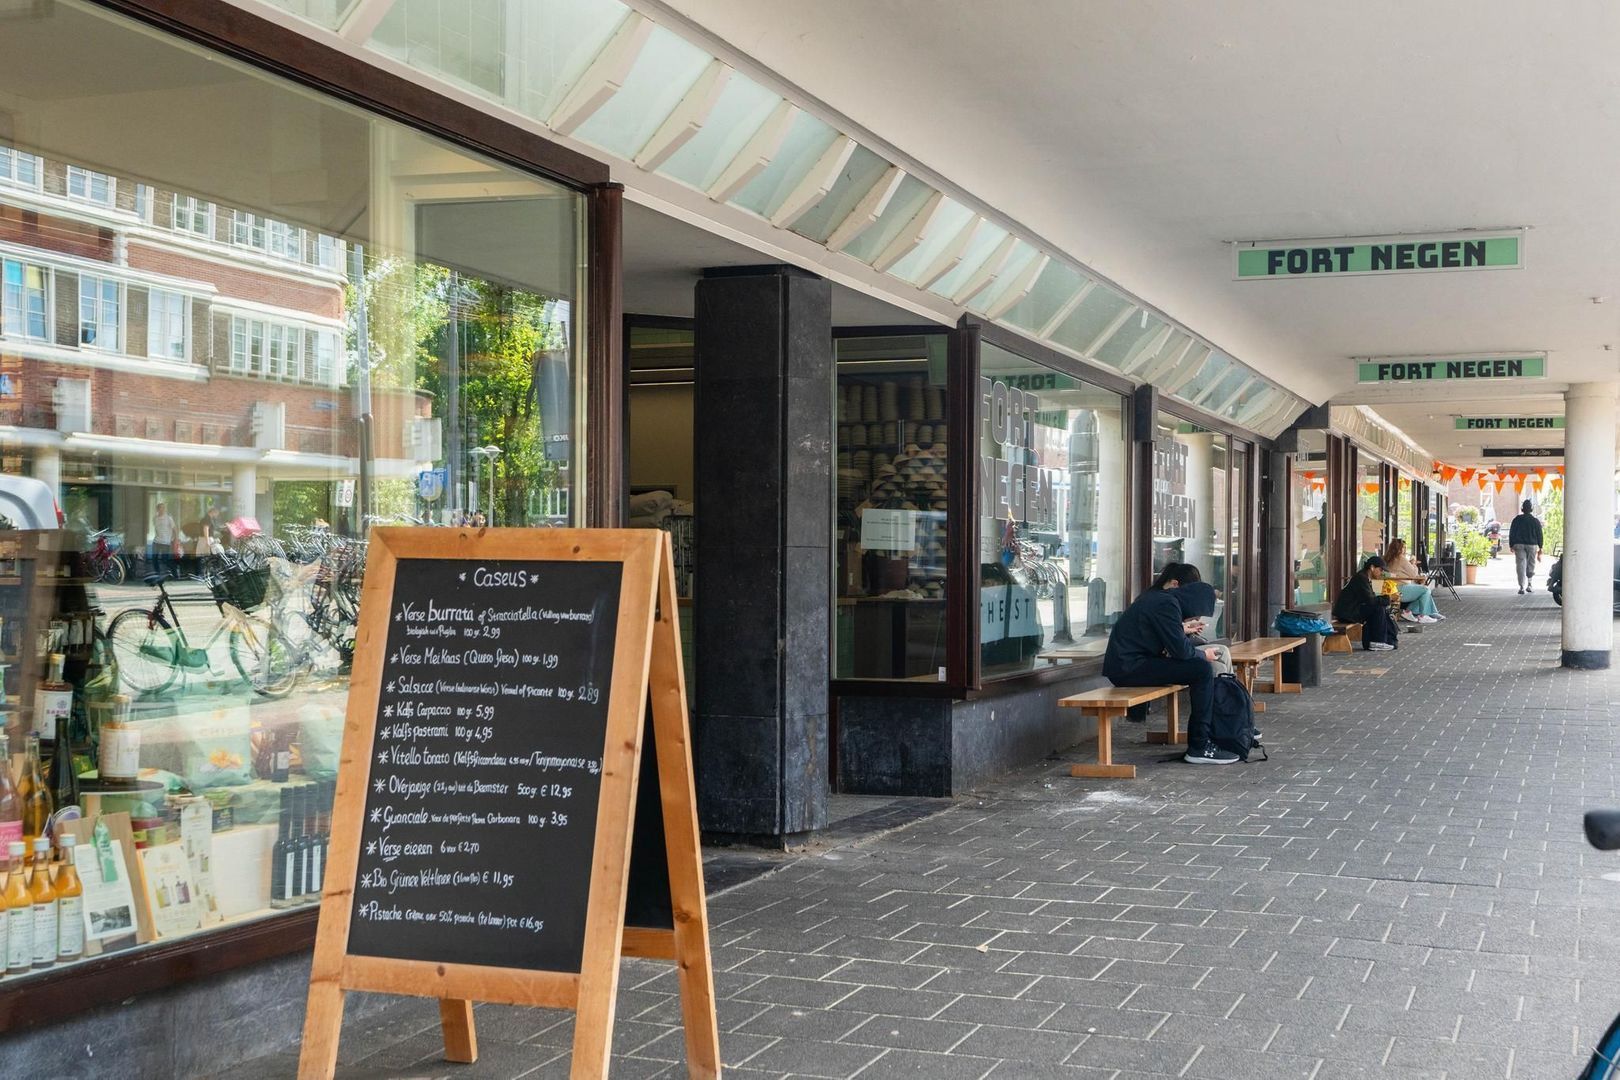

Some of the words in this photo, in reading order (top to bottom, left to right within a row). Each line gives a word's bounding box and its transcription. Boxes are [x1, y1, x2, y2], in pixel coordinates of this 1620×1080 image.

[1267, 247, 1355, 275] FORT
[1371, 241, 1487, 271] NEGEN
[1378, 362, 1437, 381] FORT
[1446, 360, 1523, 378] NEGEN
[981, 376, 1039, 451] FORT
[1467, 418, 1503, 429] FORT
[1508, 418, 1554, 428] NEGEN
[981, 455, 1053, 526] NEGEN
[473, 567, 527, 588] Caseus
[402, 601, 426, 622] Verse
[427, 598, 474, 622] burrata
[400, 644, 421, 665] Verse
[390, 744, 422, 765] Vitello
[379, 836, 402, 856] Verse
[440, 840, 446, 853] 6
